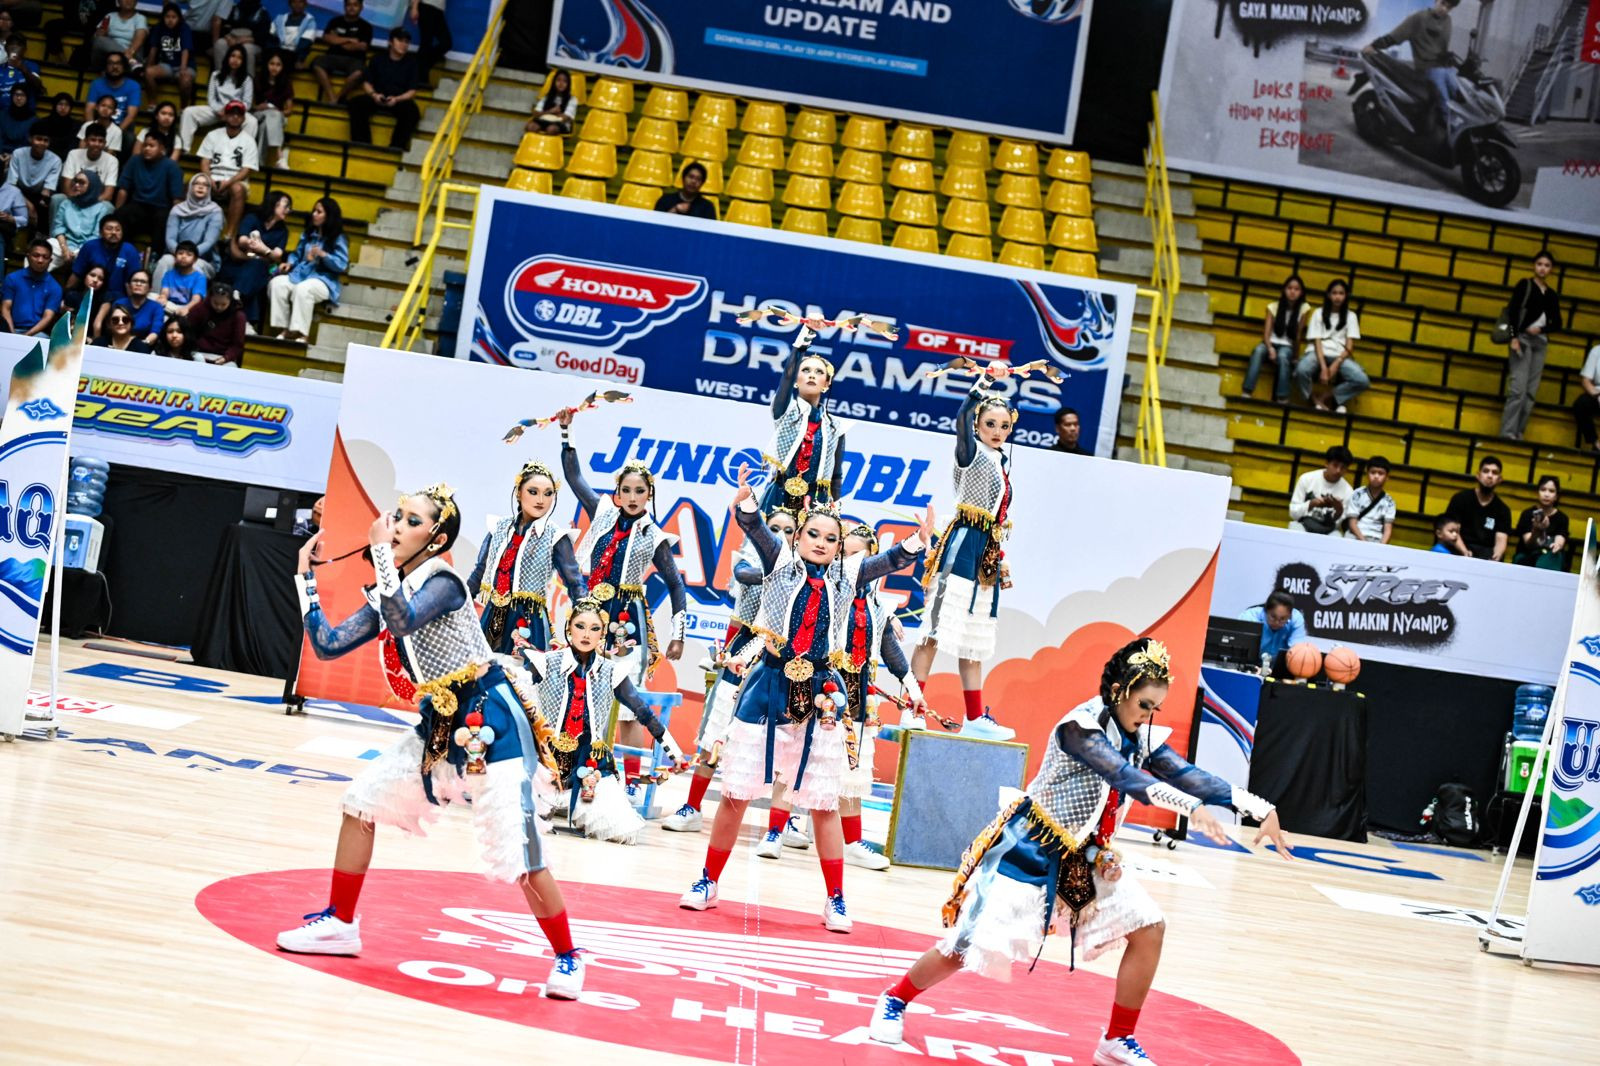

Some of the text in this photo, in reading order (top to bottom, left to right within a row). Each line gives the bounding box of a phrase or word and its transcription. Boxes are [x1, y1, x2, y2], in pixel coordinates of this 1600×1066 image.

[764, 5, 878, 40] UPDATE
[889, 0, 952, 24] AND
[1239, 2, 1267, 18] GAYA
[1270, 4, 1308, 21] MAKIN
[561, 276, 657, 303] HONDA
[555, 303, 602, 328] DBL
[708, 290, 898, 349] HOME
[918, 332, 1001, 358] OF THE
[90, 380, 168, 405] WORTH
[197, 396, 227, 413] YA
[227, 401, 287, 423] CUMA
[695, 378, 758, 401] WEST
[827, 399, 881, 419] EAST
[836, 450, 932, 508] DBL
[1283, 571, 1469, 606] PAKE STREET
[1313, 611, 1344, 630] GAYA
[1348, 614, 1390, 632] MAKIN
[420, 927, 1070, 1037] HONDA
[399, 960, 1074, 1066] One HEART
